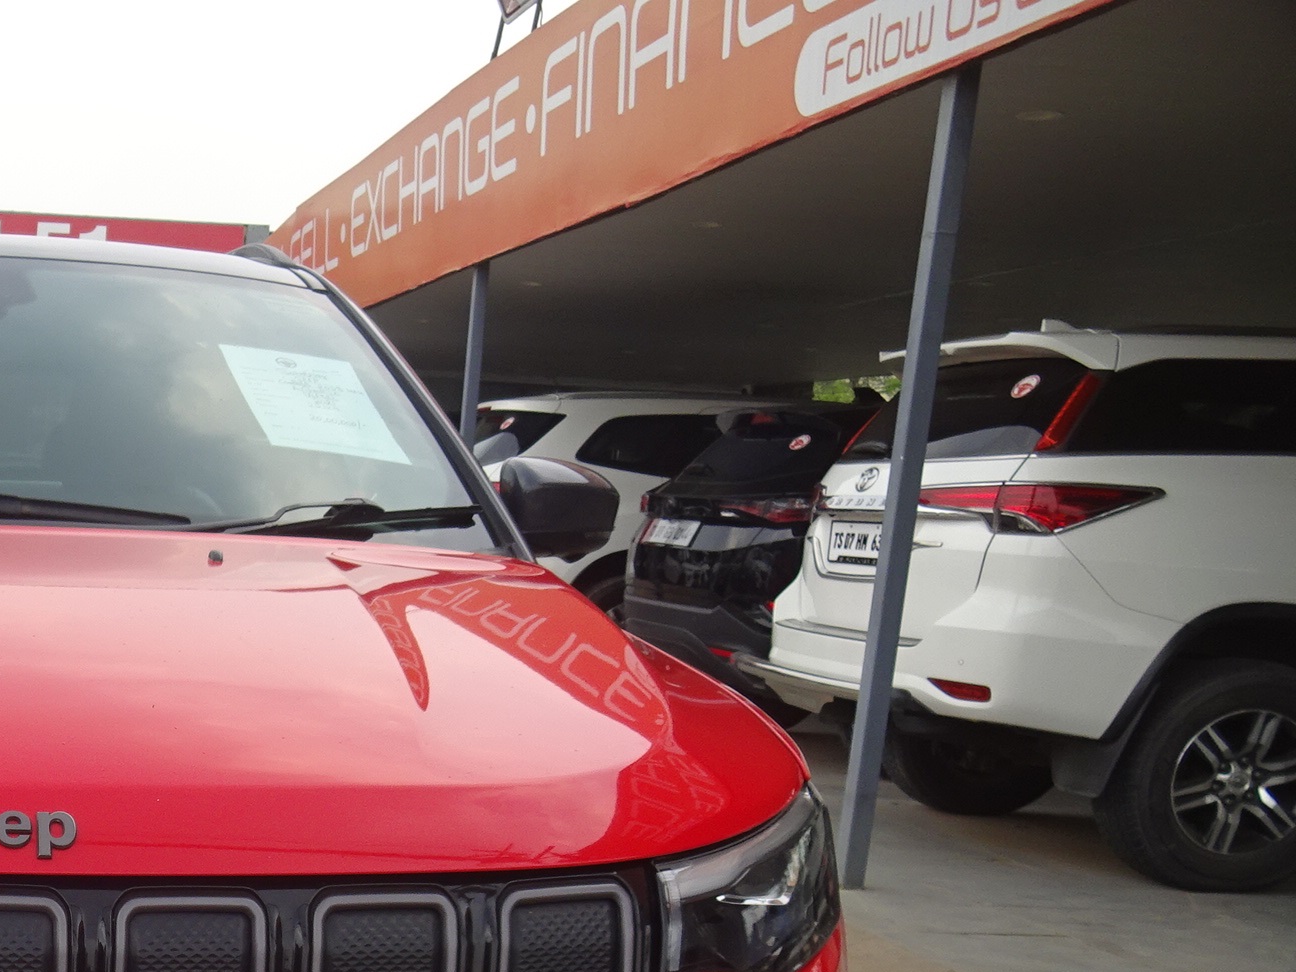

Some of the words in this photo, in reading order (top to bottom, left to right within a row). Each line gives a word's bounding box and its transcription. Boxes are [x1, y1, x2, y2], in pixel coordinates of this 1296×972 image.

[822, 5, 935, 96] Follow
[350, 75, 520, 259] EXCHANGE
[833, 532, 845, 549] TS
